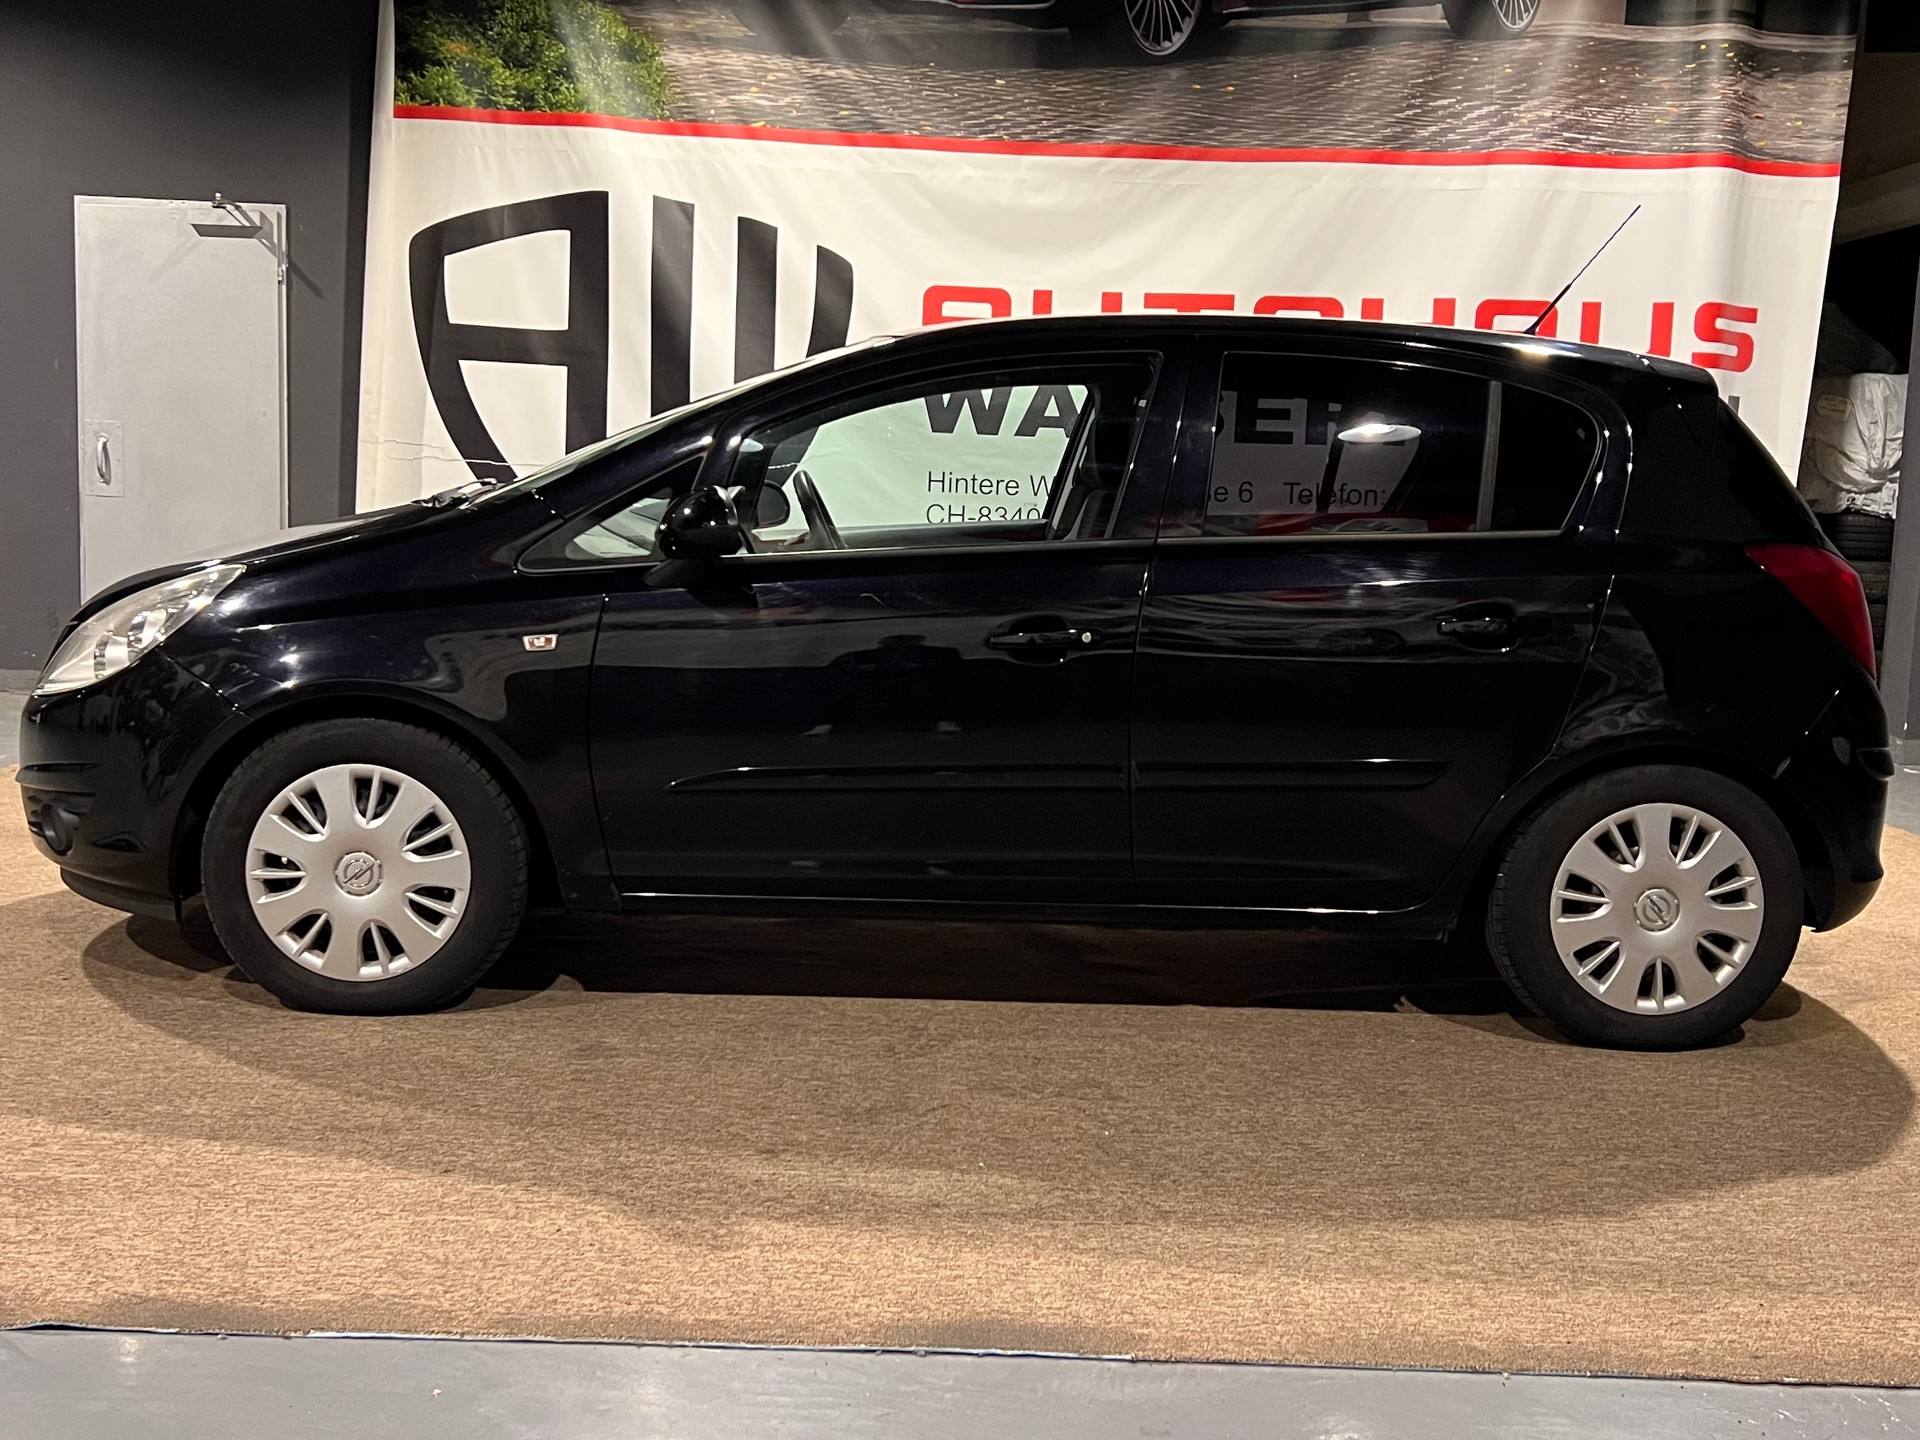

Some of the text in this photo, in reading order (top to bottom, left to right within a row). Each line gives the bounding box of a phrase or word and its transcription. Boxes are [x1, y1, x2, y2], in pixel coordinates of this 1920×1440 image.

[922, 285, 1758, 373] AAUS
[928, 471, 1019, 496] Hintere
[1238, 481, 1253, 503] 6
